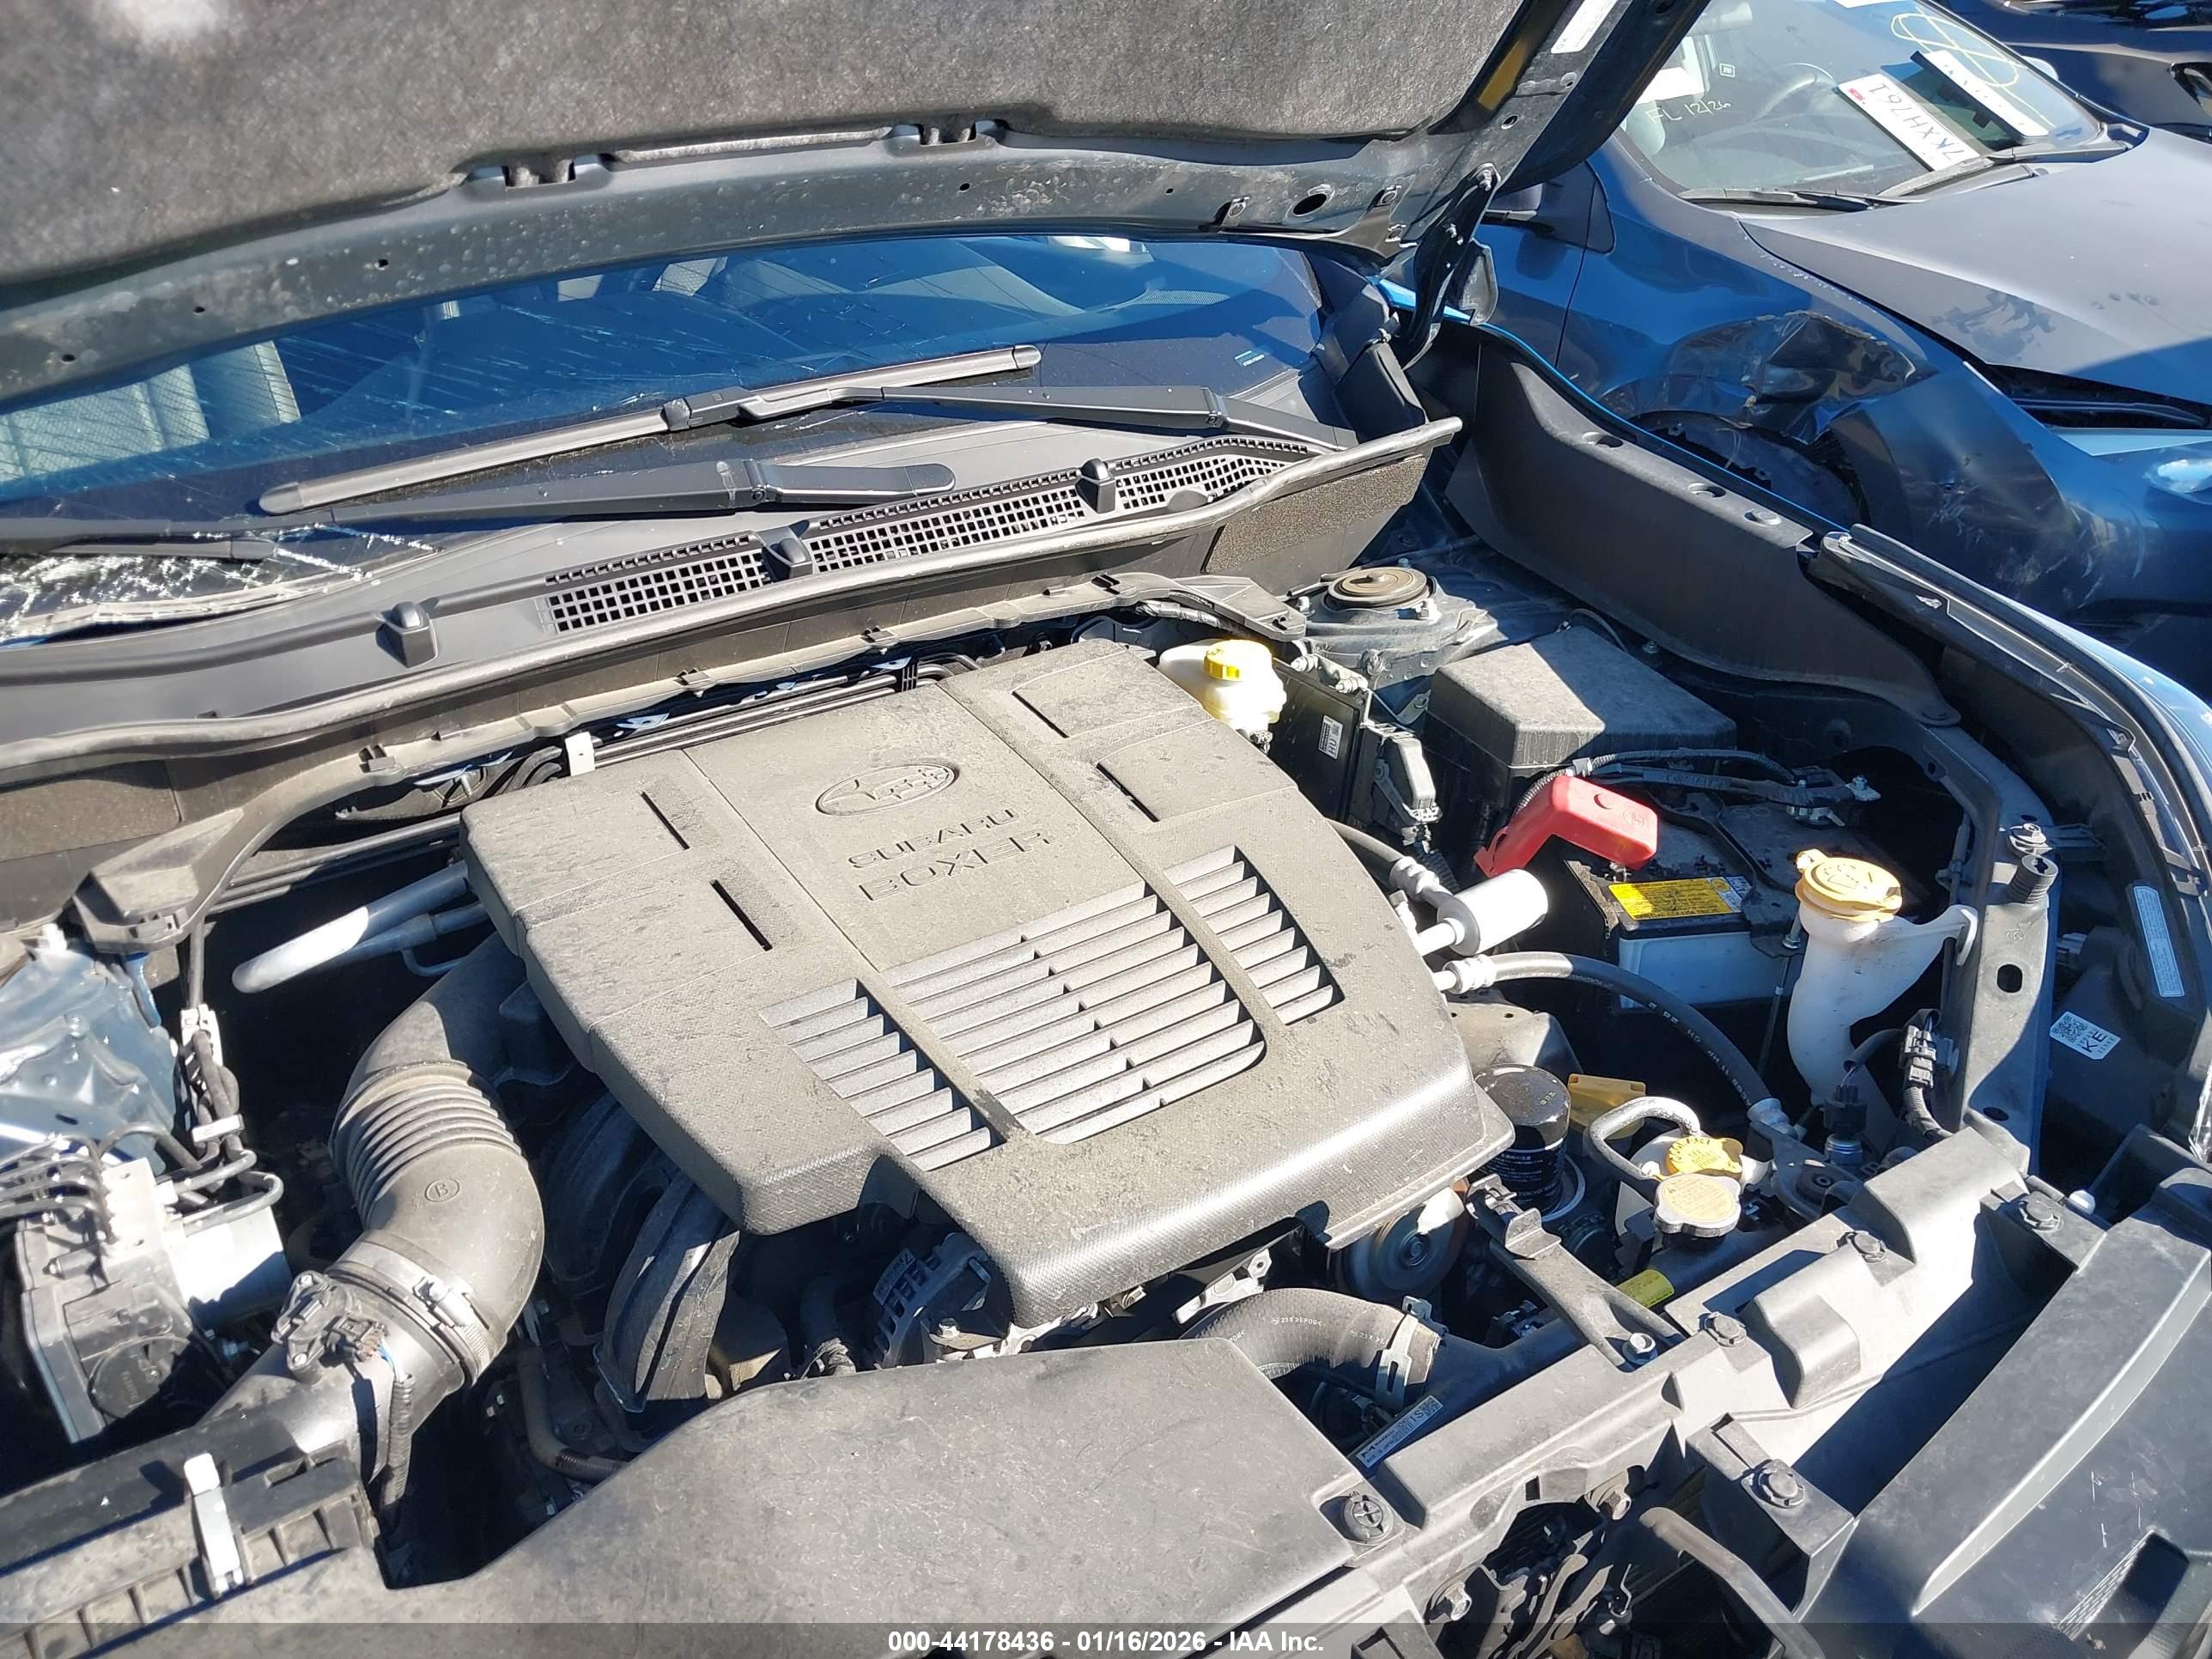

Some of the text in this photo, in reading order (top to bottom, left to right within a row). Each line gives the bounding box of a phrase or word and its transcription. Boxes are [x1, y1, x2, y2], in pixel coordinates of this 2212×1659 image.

[848, 808, 1020, 868] SUBARU
[858, 829, 1058, 902] BOXER
[2081, 1030, 2108, 1054] KE
[434, 1182, 449, 1199] B
